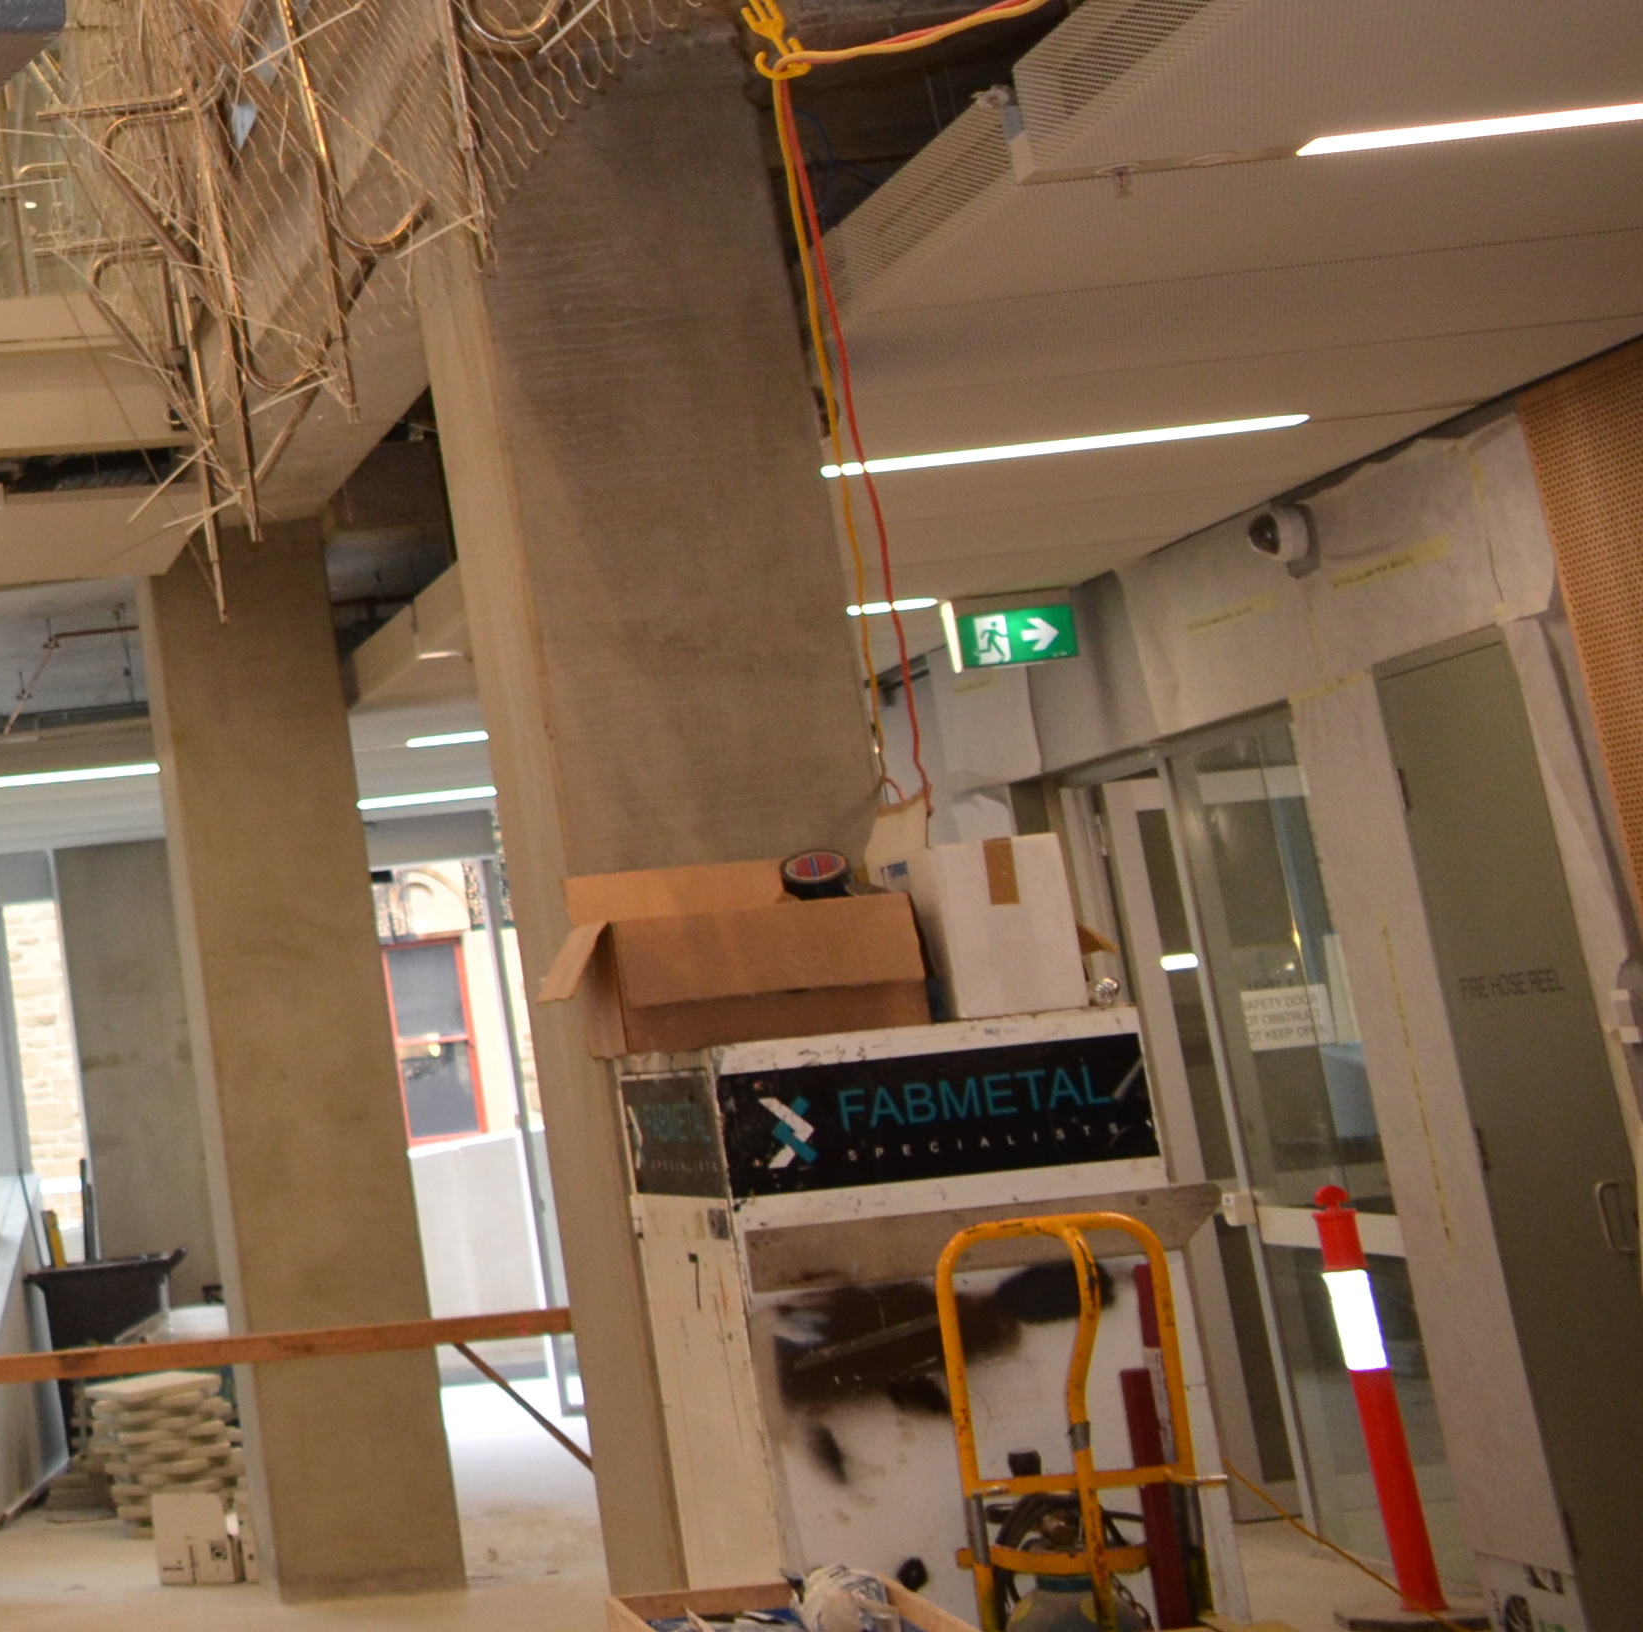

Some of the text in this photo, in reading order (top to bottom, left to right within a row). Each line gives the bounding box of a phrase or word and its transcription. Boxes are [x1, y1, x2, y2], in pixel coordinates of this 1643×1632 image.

[1458, 968, 1567, 1000] FIRE HOSE REEL
[838, 1065, 1114, 1132] FABMETAL
[848, 1122, 1119, 1162] SPECIALISTS
